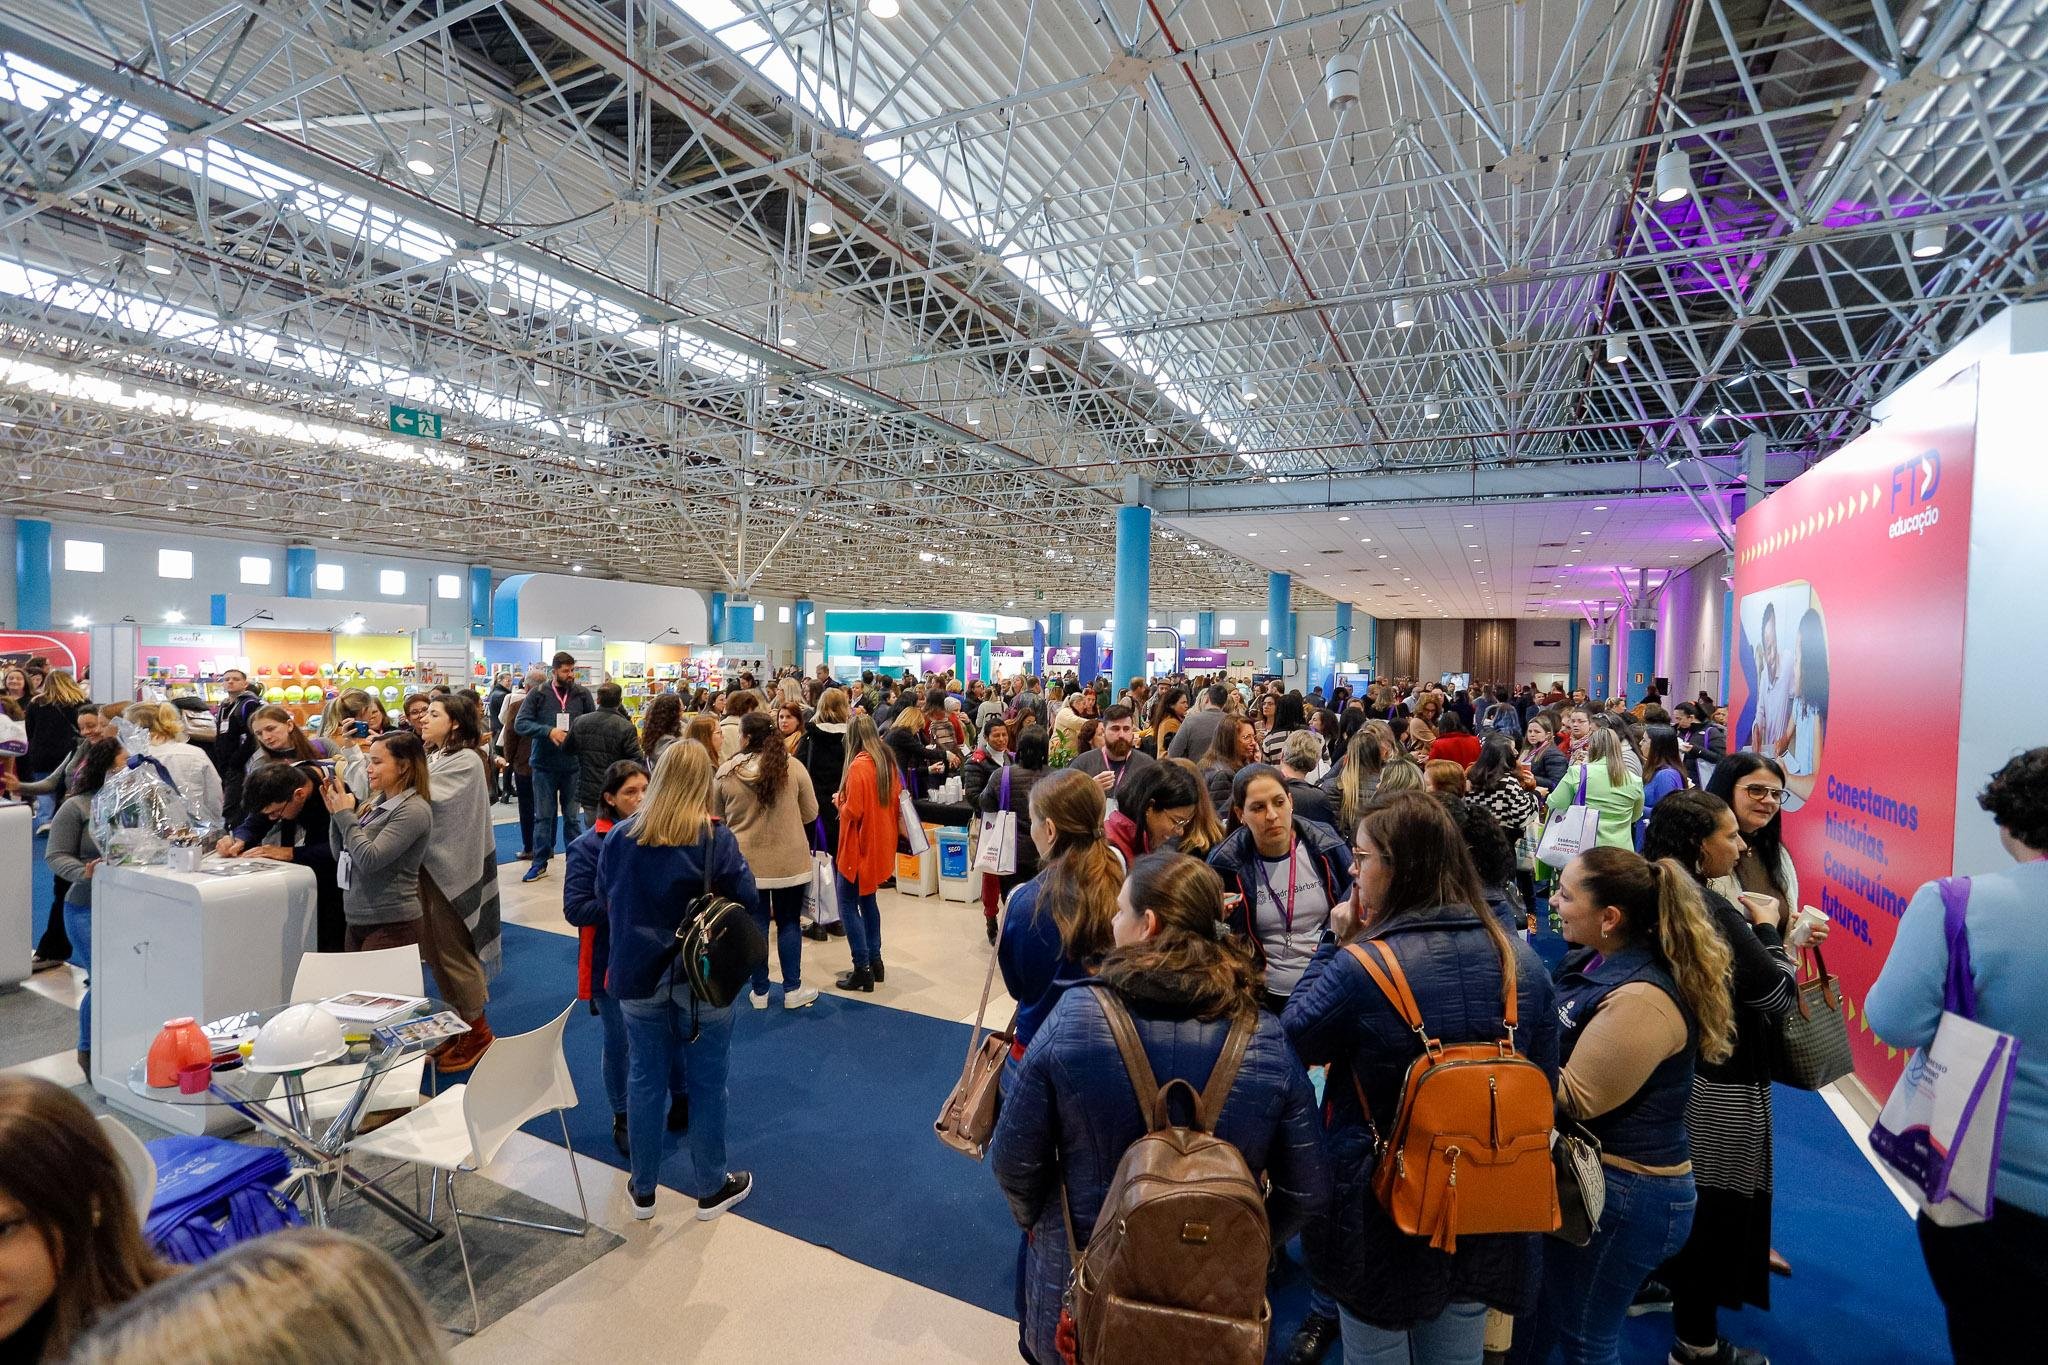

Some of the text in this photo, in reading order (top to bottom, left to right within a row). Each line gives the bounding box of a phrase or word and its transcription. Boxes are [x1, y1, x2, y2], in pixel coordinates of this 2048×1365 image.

[1891, 449, 1940, 514] FTD
[1888, 505, 1940, 539] educação
[1827, 774, 1919, 832] Conectamos
[1825, 810, 1889, 867] histórias.
[1823, 850, 1909, 920] Construímo
[1821, 884, 1873, 947] futuros.
